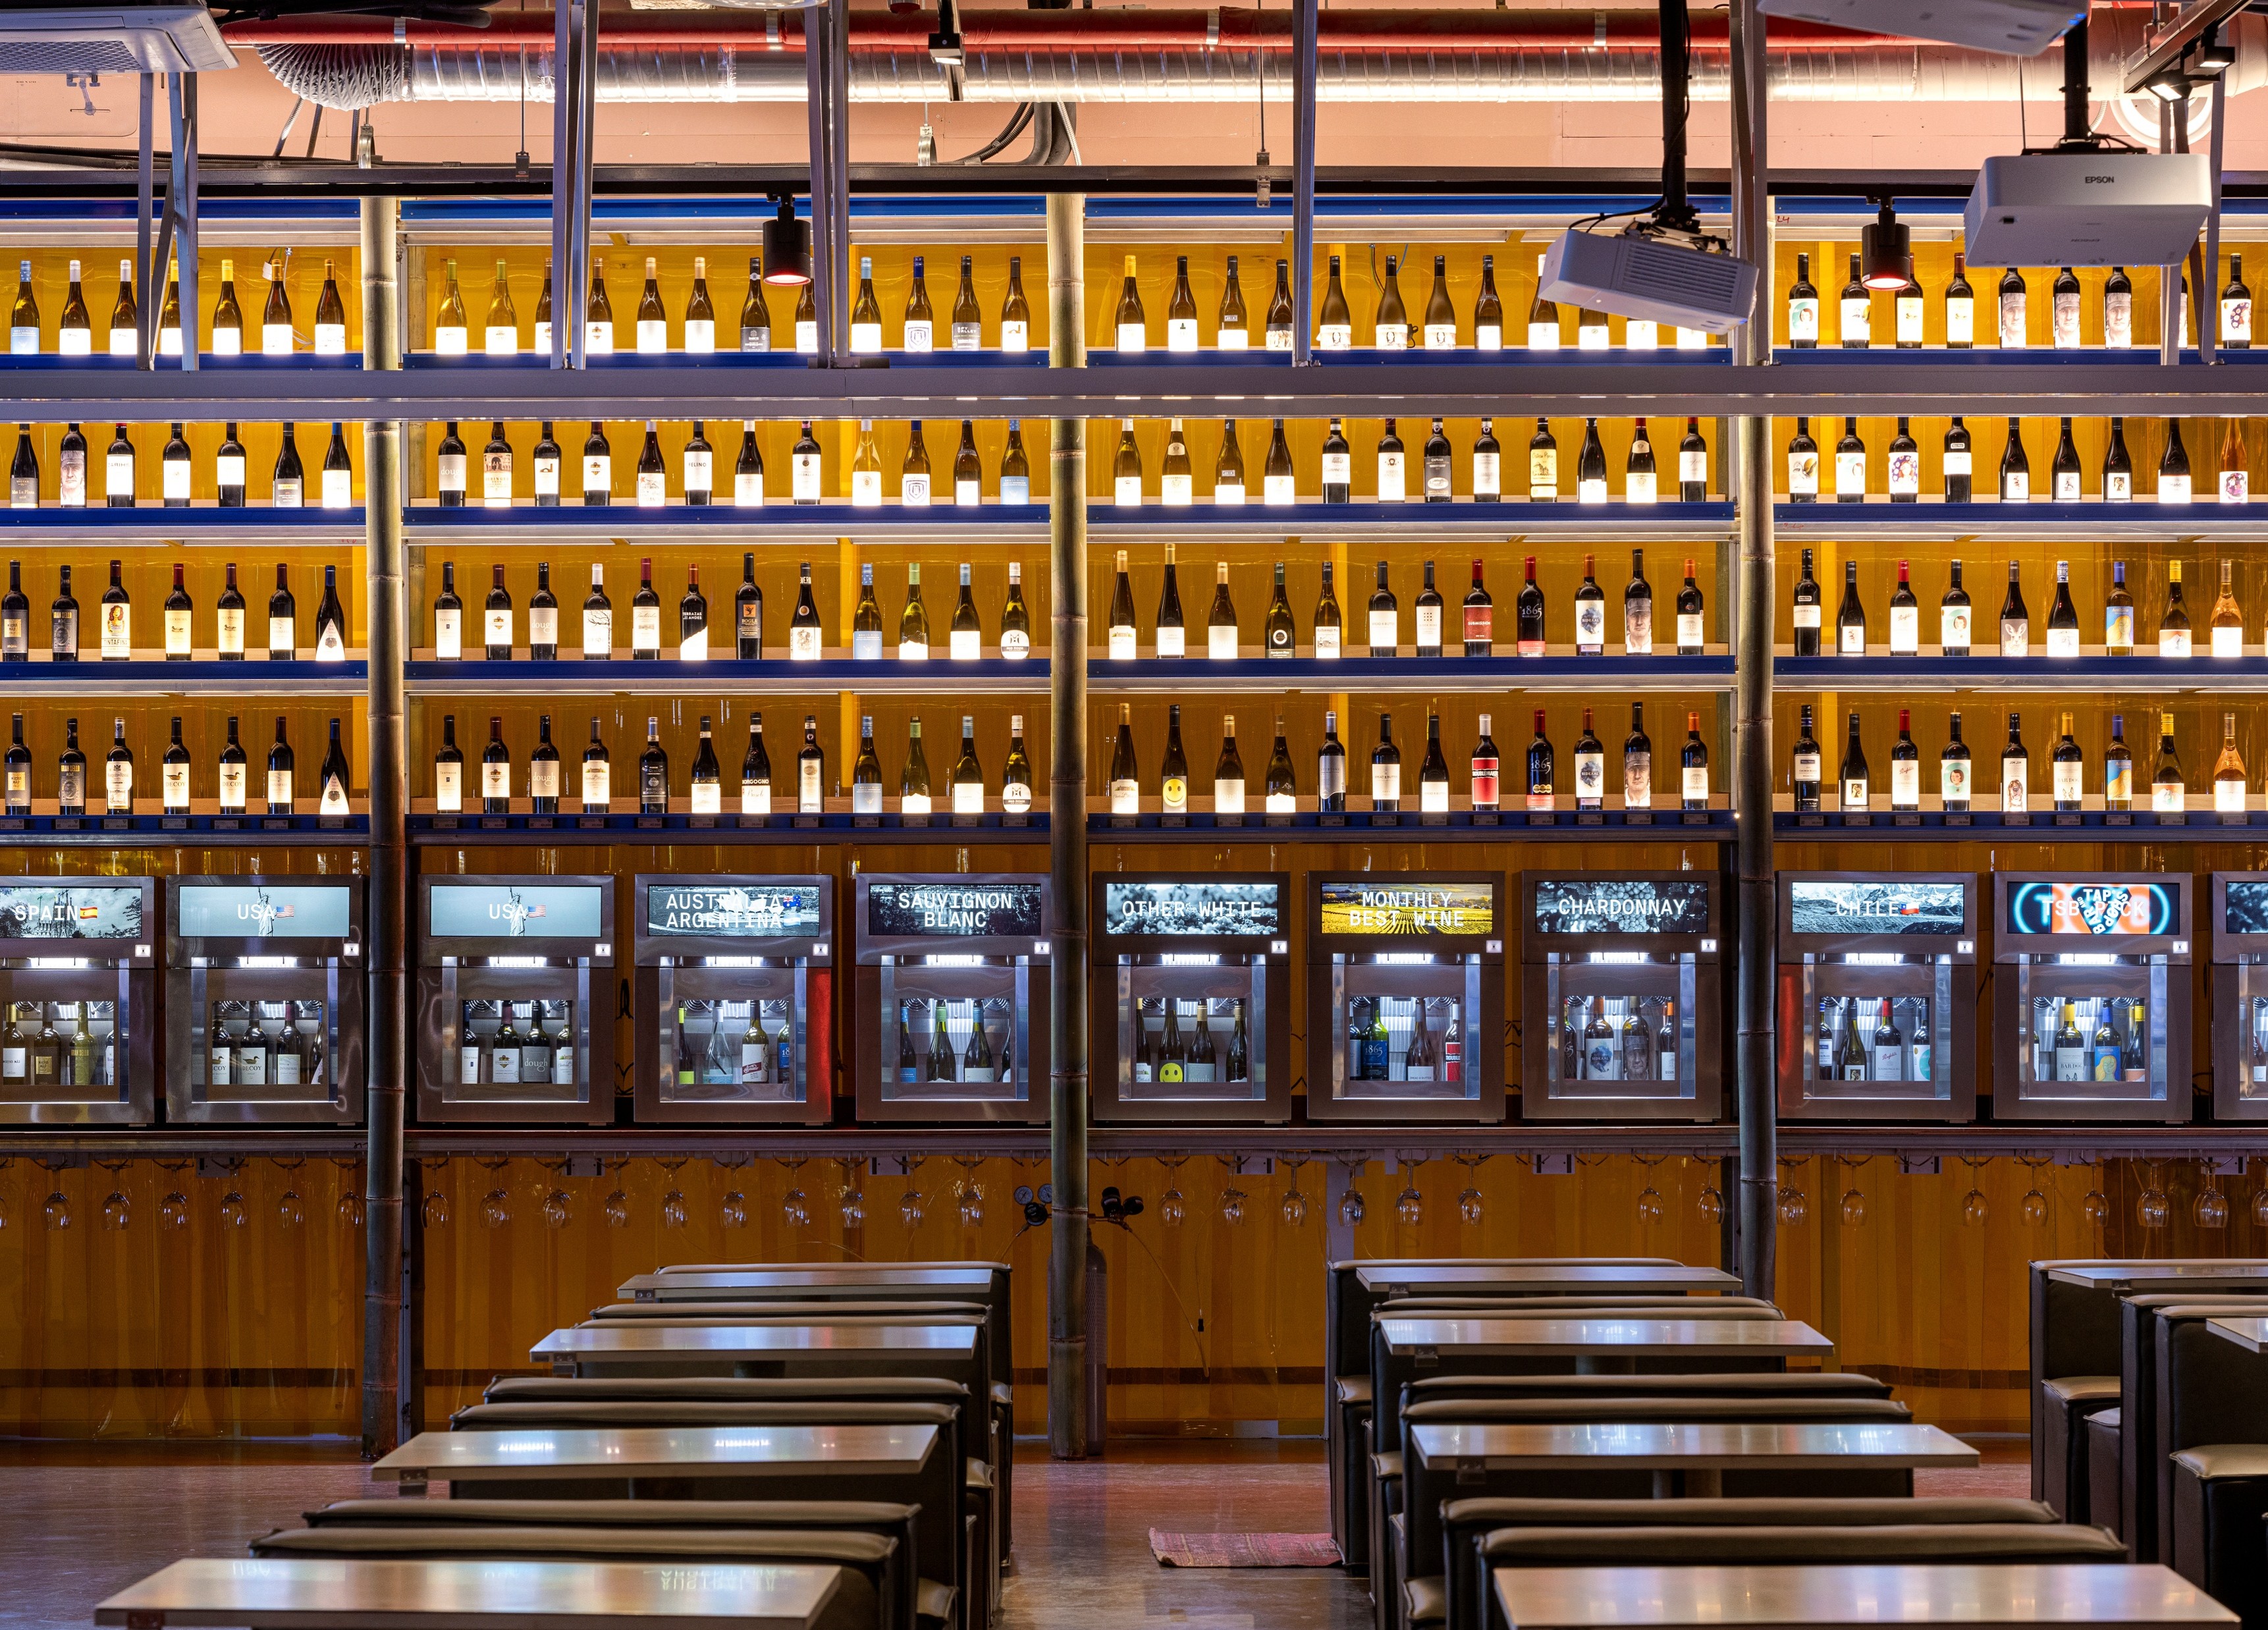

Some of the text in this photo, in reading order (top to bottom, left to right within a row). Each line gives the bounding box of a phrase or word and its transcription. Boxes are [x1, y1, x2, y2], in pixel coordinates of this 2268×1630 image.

[1522, 603, 1542, 620] 1865
[531, 619, 554, 634] dough
[1530, 758, 1551, 774] 1865
[533, 773, 556, 786] dough
[666, 894, 782, 910] AUSTRALIA
[898, 893, 1012, 909] SAUVIGNON
[1362, 892, 1453, 908] MONTHLY
[1558, 898, 1687, 915] CHARDONNAY
[1836, 900, 1899, 916] CHILE
[2041, 900, 2080, 916] TSB
[15, 905, 78, 921] SPAIN
[237, 903, 275, 920] USA
[489, 903, 526, 919] USA
[1122, 901, 1262, 917] OTHER WHITE
[666, 912, 782, 928] ARGENTINA
[924, 911, 987, 927] BLANC
[1349, 910, 1465, 927] BEST WINE
[1364, 1043, 1383, 1058] 1865
[524, 1058, 548, 1072] dough
